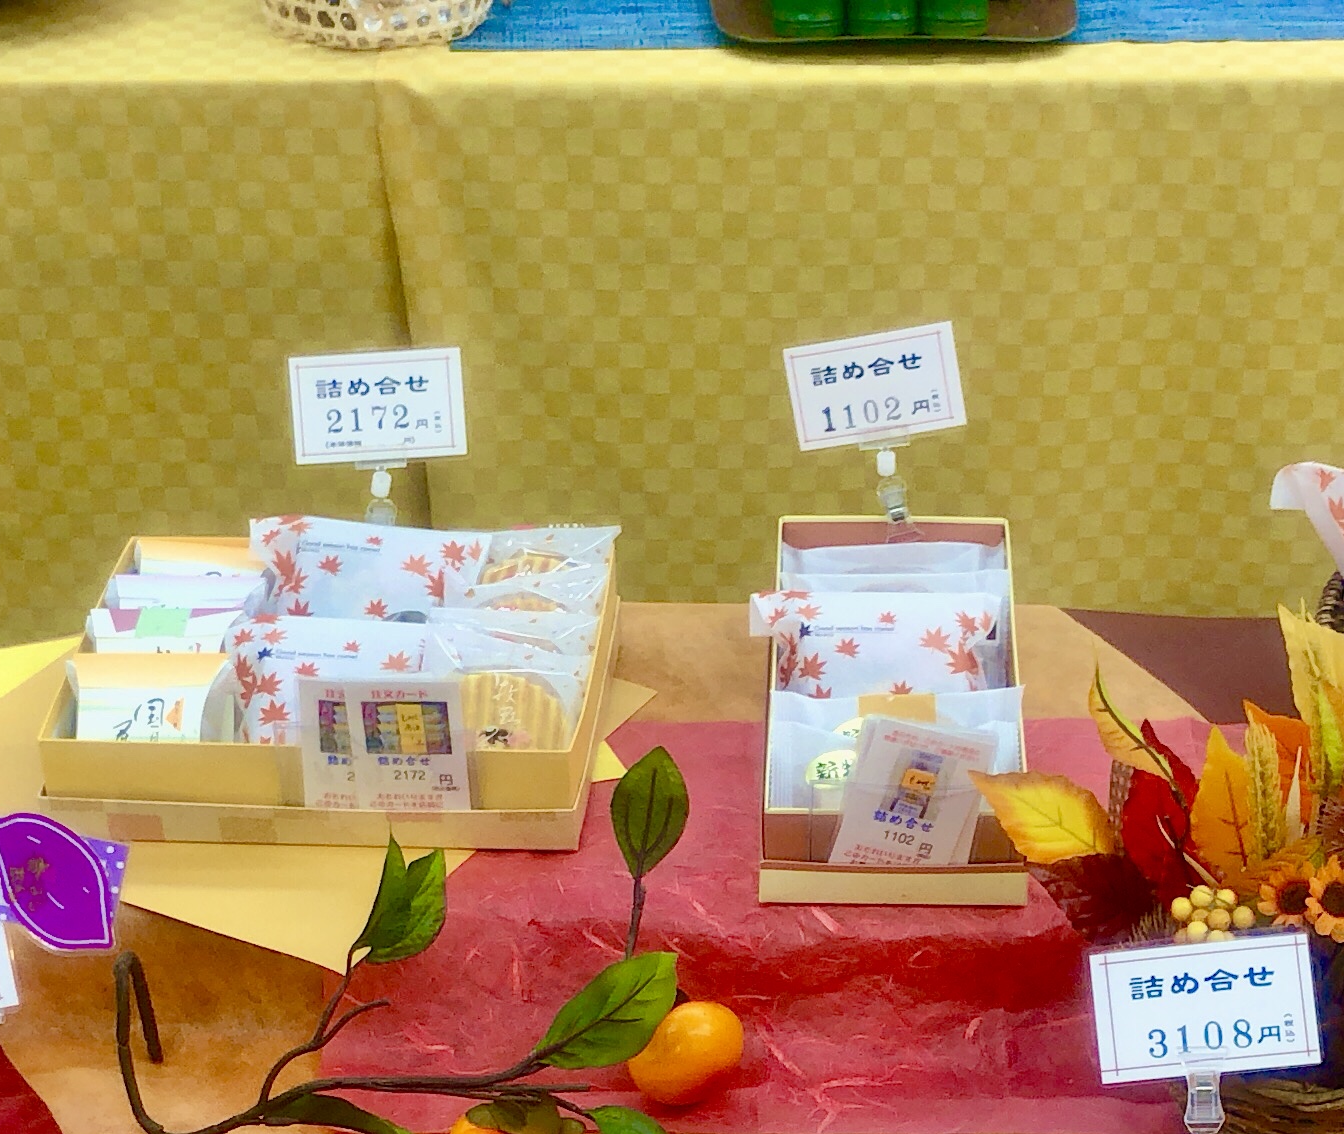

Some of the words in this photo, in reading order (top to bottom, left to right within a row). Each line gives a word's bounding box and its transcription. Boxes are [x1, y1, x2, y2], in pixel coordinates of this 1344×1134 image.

[811, 353, 922, 387] 詰め合せ
[315, 376, 429, 399] 詰め合せ
[1129, 966, 1275, 1000] 詰め合せ
